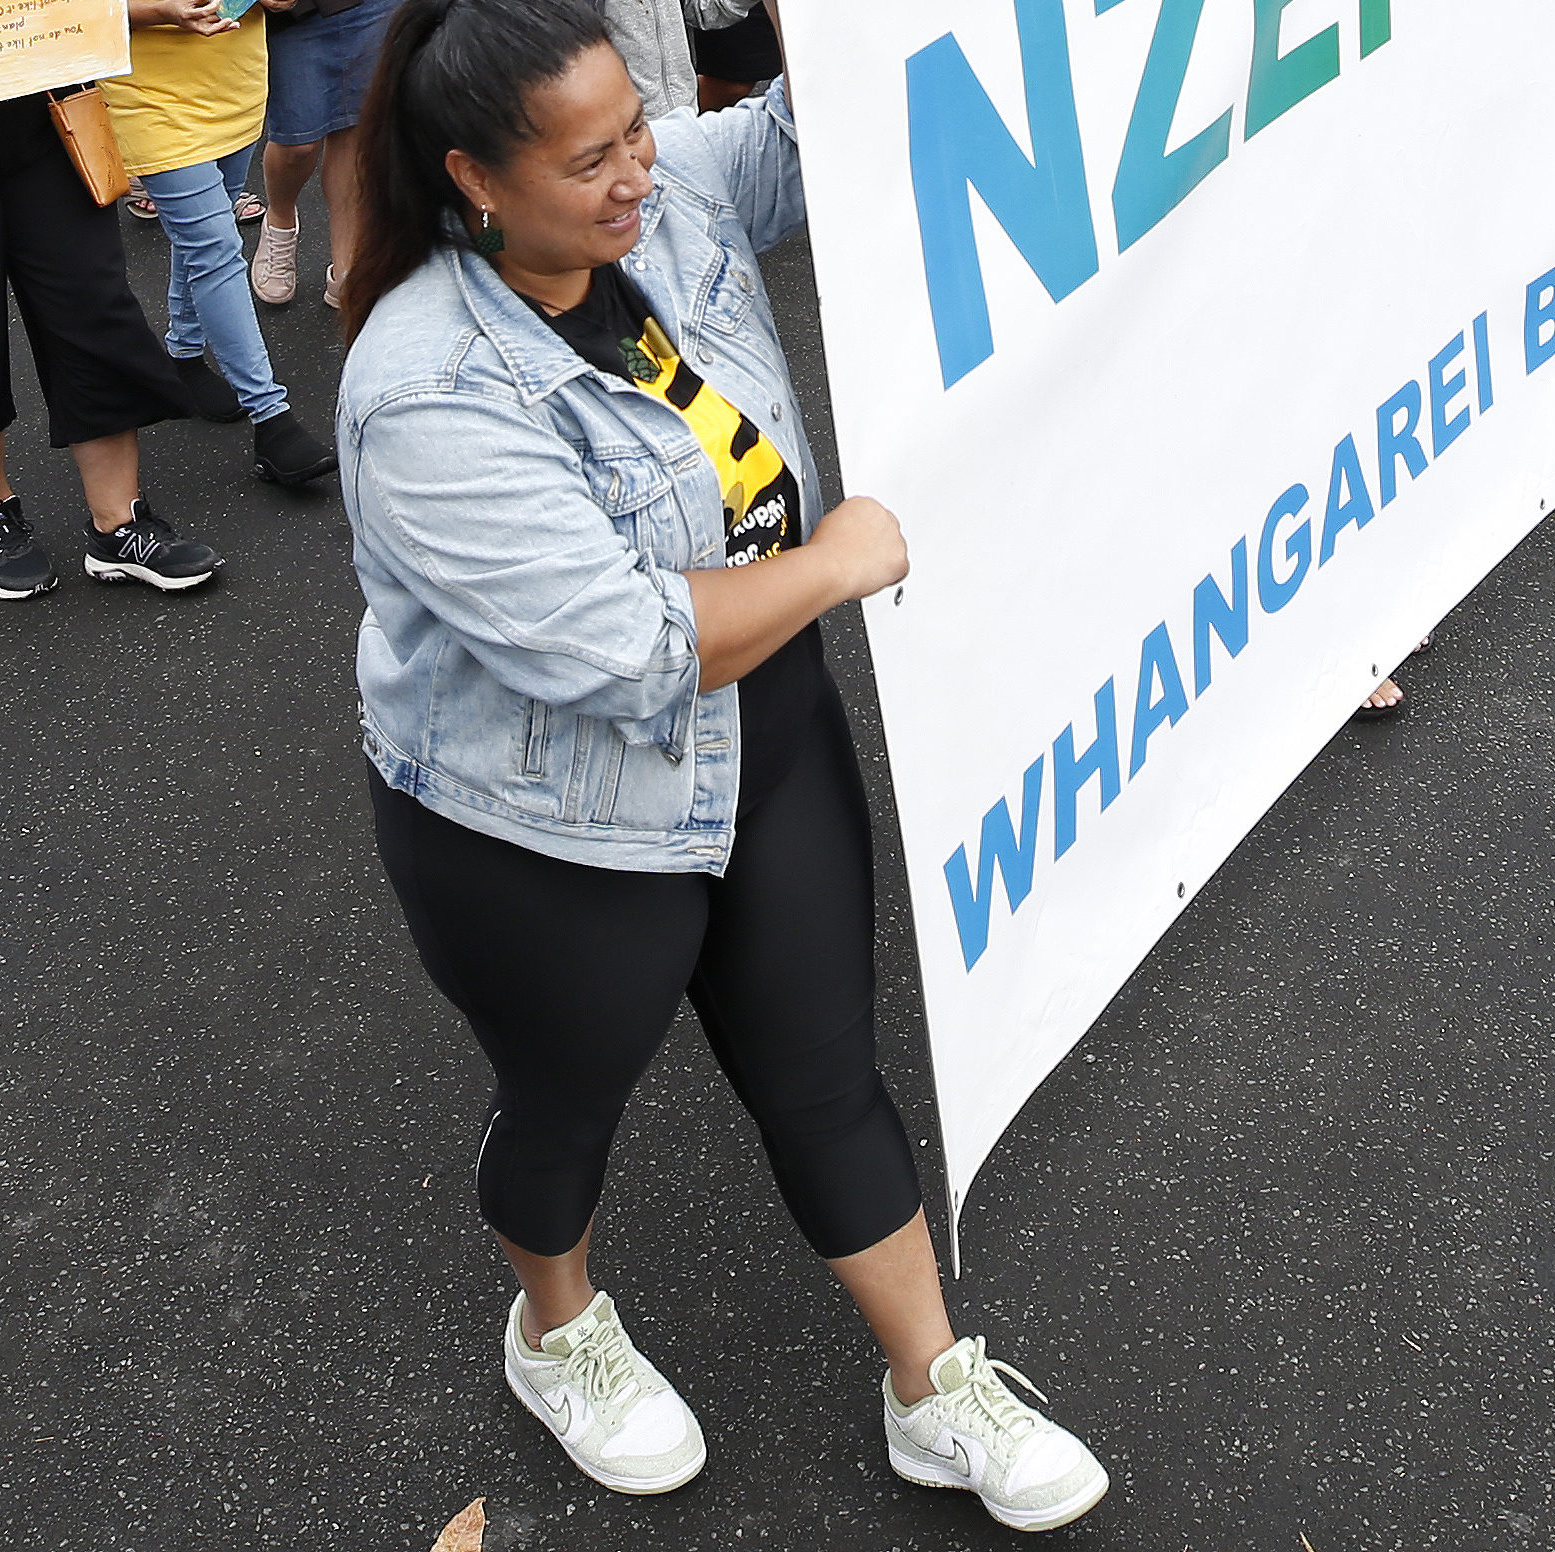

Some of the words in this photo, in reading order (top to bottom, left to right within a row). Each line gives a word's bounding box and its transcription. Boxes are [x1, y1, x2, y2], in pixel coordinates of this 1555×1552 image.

[6, 5, 16, 15] it
[48, 29, 61, 41] do
[63, 23, 84, 36] You
[6, 36, 25, 49] like
[29, 32, 46, 48] not
[941, 308, 1496, 975] WHANGAREI
